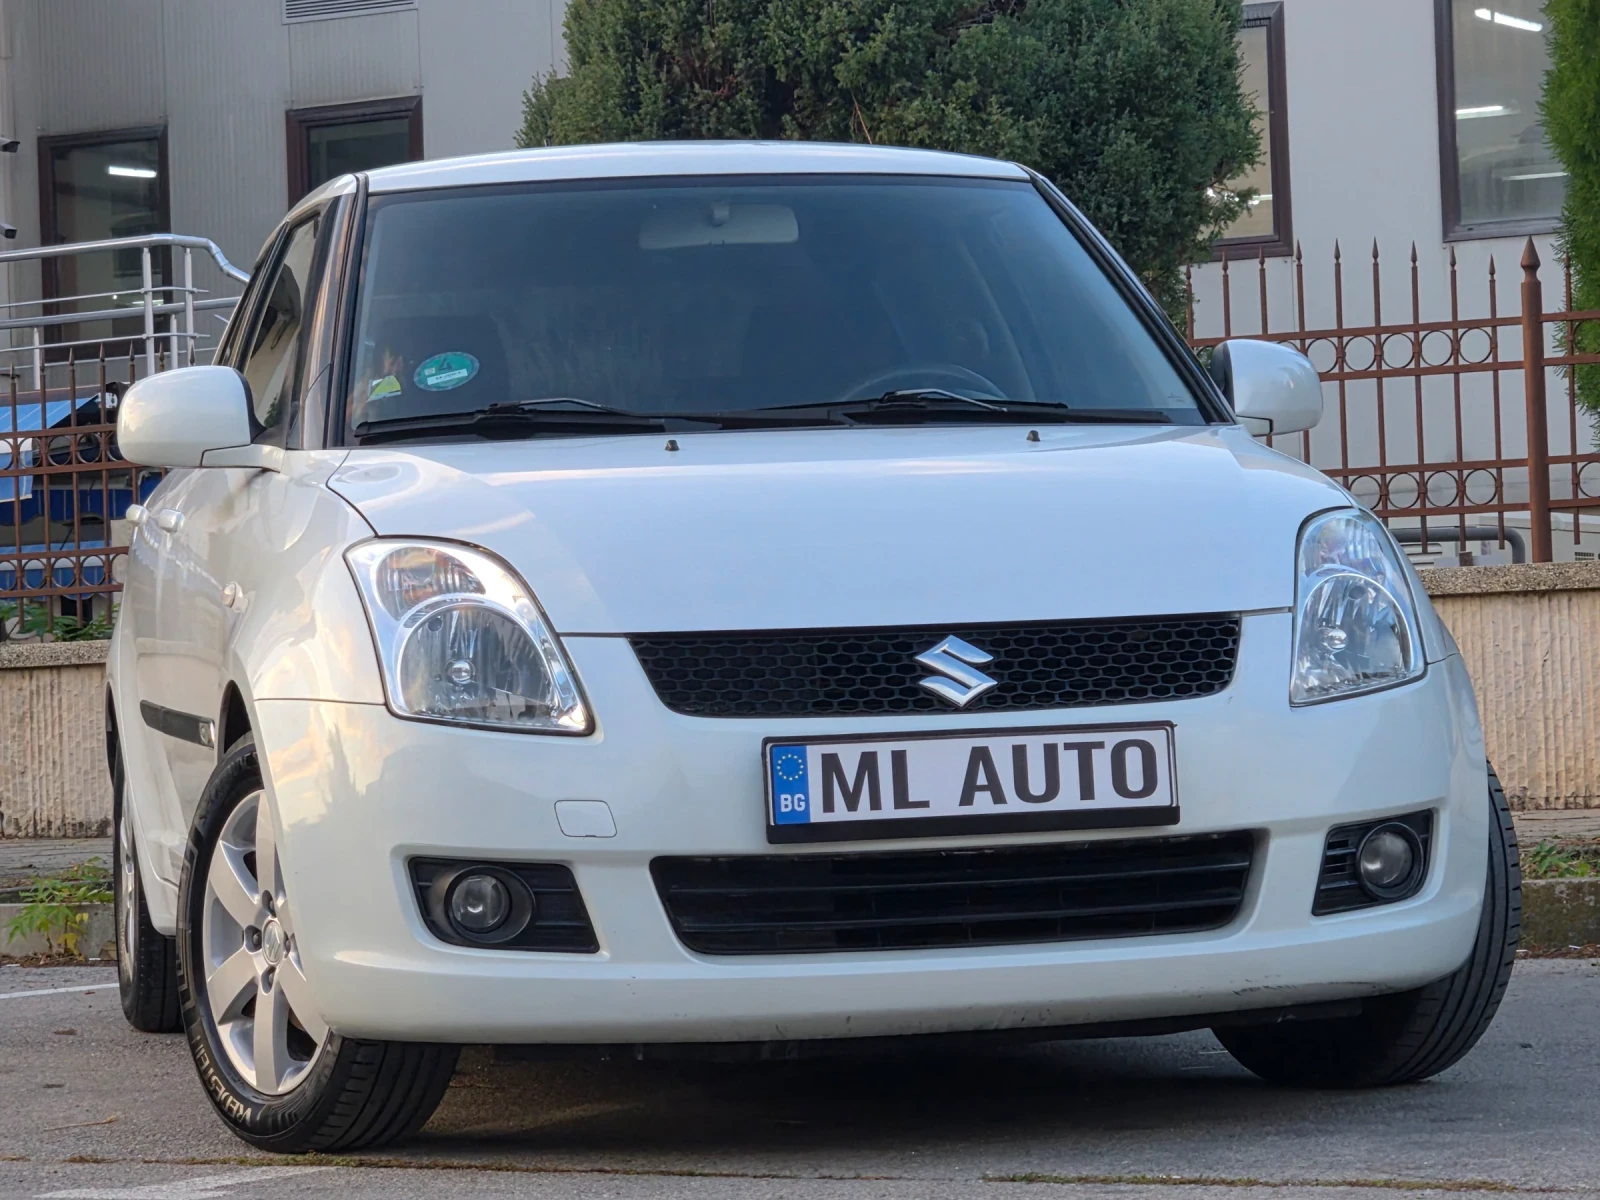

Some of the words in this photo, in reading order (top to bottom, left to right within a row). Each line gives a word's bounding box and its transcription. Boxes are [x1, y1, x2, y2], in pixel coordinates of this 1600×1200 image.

[821, 749, 930, 813] ML
[958, 738, 1158, 806] AUTO
[780, 793, 806, 813] BG
